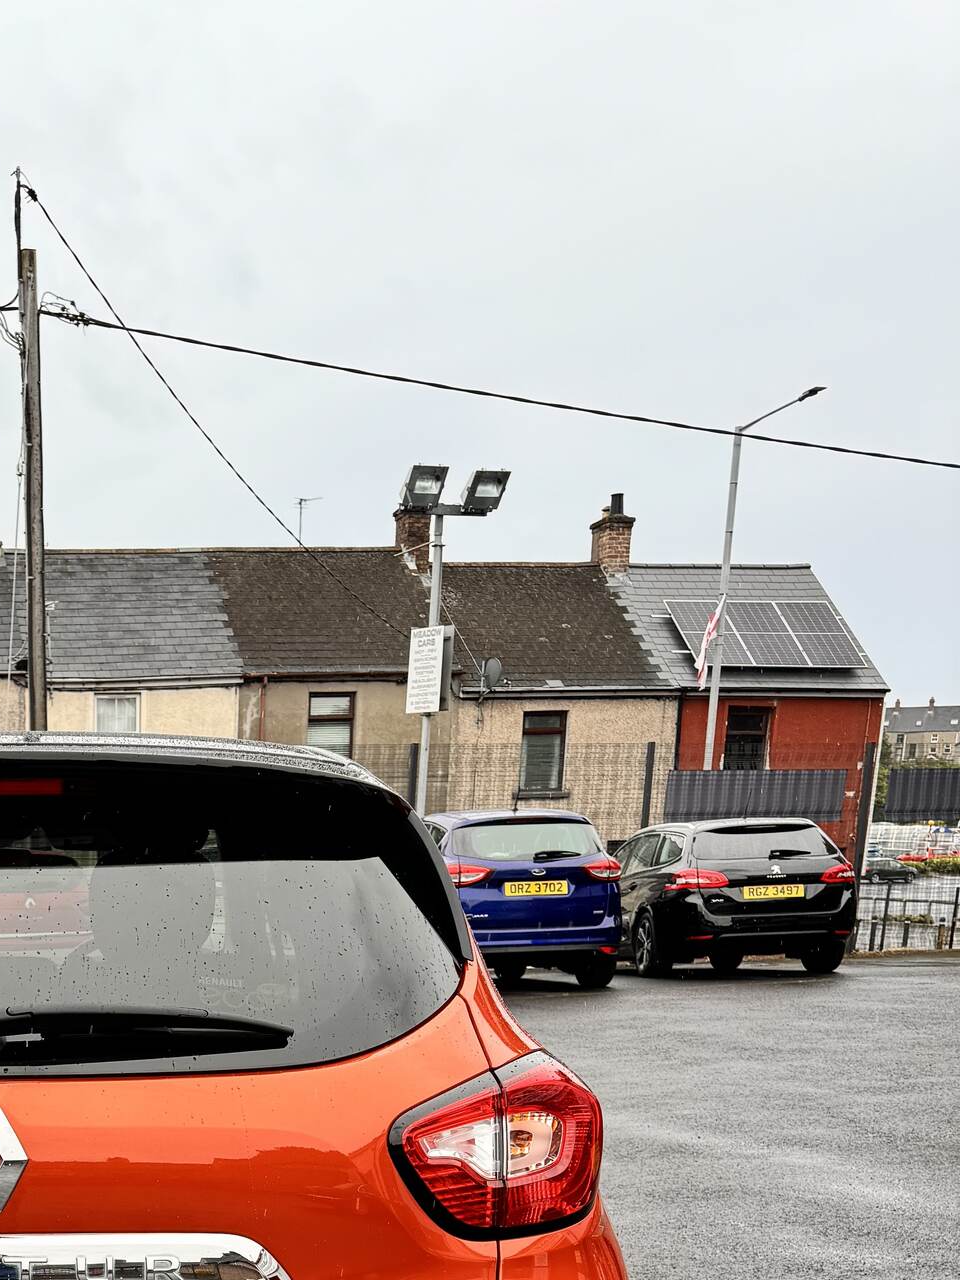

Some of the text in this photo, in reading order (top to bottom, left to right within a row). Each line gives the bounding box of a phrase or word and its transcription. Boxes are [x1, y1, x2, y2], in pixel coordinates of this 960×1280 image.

[413, 629, 442, 640] MEADOW
[417, 638, 436, 647] CARS
[510, 881, 563, 894] ORZ 3702
[748, 886, 800, 897] RGZ 3497
